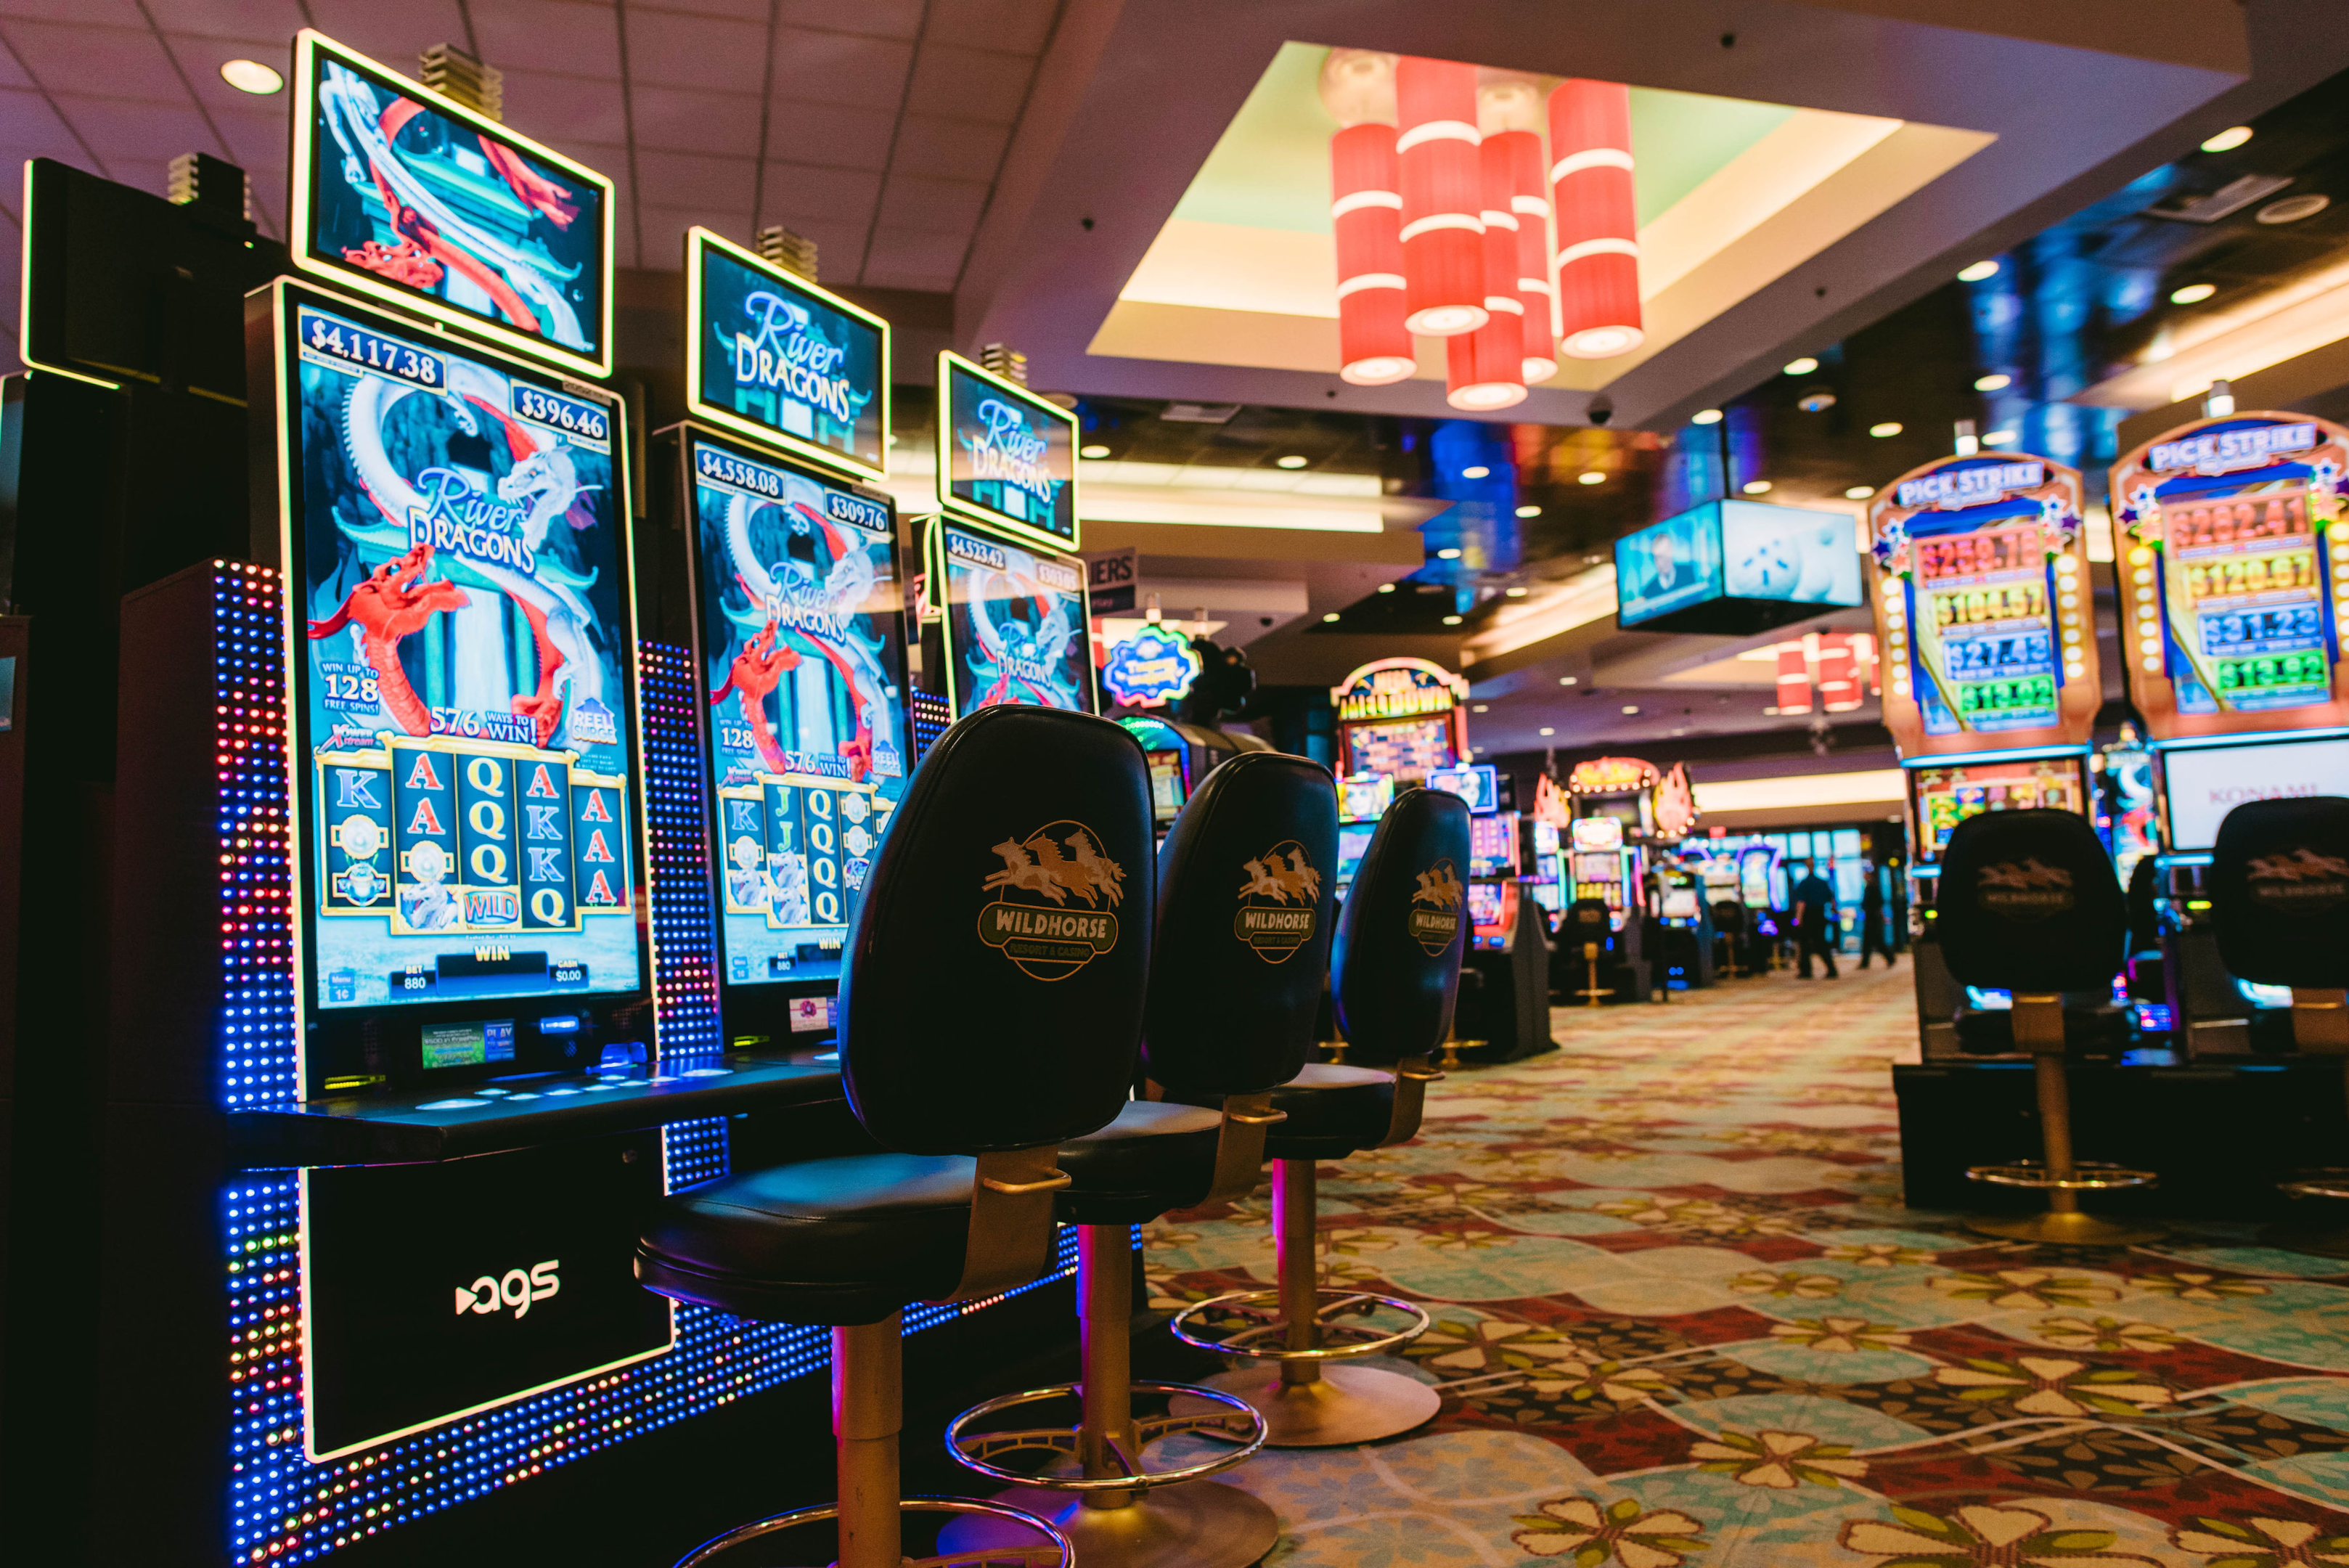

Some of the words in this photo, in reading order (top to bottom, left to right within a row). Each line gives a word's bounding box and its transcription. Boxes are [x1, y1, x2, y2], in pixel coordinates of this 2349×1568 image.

[745, 290, 843, 374] River
[311, 319, 436, 383] $4,117.38
[736, 332, 850, 422] DRAGONS
[522, 390, 603, 438] $396.46
[979, 399, 1047, 465] River
[2152, 437, 2215, 470] PICK
[2218, 423, 2316, 457] STRIKE
[703, 452, 780, 497] $4,558.08
[972, 435, 1052, 502] DRAGONS
[1899, 473, 1953, 505] PICK
[1958, 462, 2043, 494] STRIKE
[417, 467, 526, 533] River
[832, 496, 885, 531] $309.76
[409, 507, 535, 573] DRAGONS
[1090, 556, 1132, 584] IERS
[770, 562, 839, 611] River
[766, 594, 845, 642] DRAGONS
[2206, 609, 2319, 642] $31.23
[322, 663, 343, 672] WIN
[347, 664, 361, 674] UP
[364, 667, 379, 679] TO
[324, 674, 379, 703] 128
[324, 699, 346, 709] FREE
[349, 701, 379, 713] SPINS!
[430, 706, 480, 736] 576
[486, 712, 514, 724] WAYS
[515, 714, 530, 726] TO
[574, 710, 612, 727] REEL
[487, 717, 537, 745] WIN!
[573, 724, 615, 739] SURGE
[722, 727, 753, 748] 128
[405, 753, 443, 790] A
[785, 751, 815, 773] 576
[820, 757, 851, 778] WIN!
[873, 751, 899, 764] REEL
[336, 769, 380, 808] K
[467, 758, 504, 796] Q
[527, 764, 559, 798] A
[407, 798, 445, 834] A
[582, 789, 612, 822] A
[731, 801, 758, 830] K
[775, 786, 791, 817] J
[809, 790, 832, 820] Q
[469, 801, 506, 839] Q
[527, 806, 562, 839] K
[584, 830, 614, 862] A
[777, 822, 793, 851] J
[811, 824, 834, 854] Q
[471, 844, 507, 883] Q
[528, 848, 565, 881] K
[814, 858, 836, 888] Q
[586, 870, 616, 902] A
[464, 895, 517, 920] WILD
[531, 889, 565, 926] Q
[816, 892, 839, 922] Q
[1245, 912, 1310, 930] WILDHORSE
[997, 909, 1107, 939] WILDHORSE
[474, 945, 510, 962] WIN
[819, 936, 841, 950] WIN
[1010, 944, 1048, 956] RESORT
[1057, 947, 1090, 957] CASINO
[405, 965, 422, 974] BET
[555, 970, 581, 982] $0.00
[557, 960, 578, 968] CASH
[332, 975, 351, 984] Menu
[335, 989, 349, 1000] 1¢
[404, 977, 425, 989] 880
